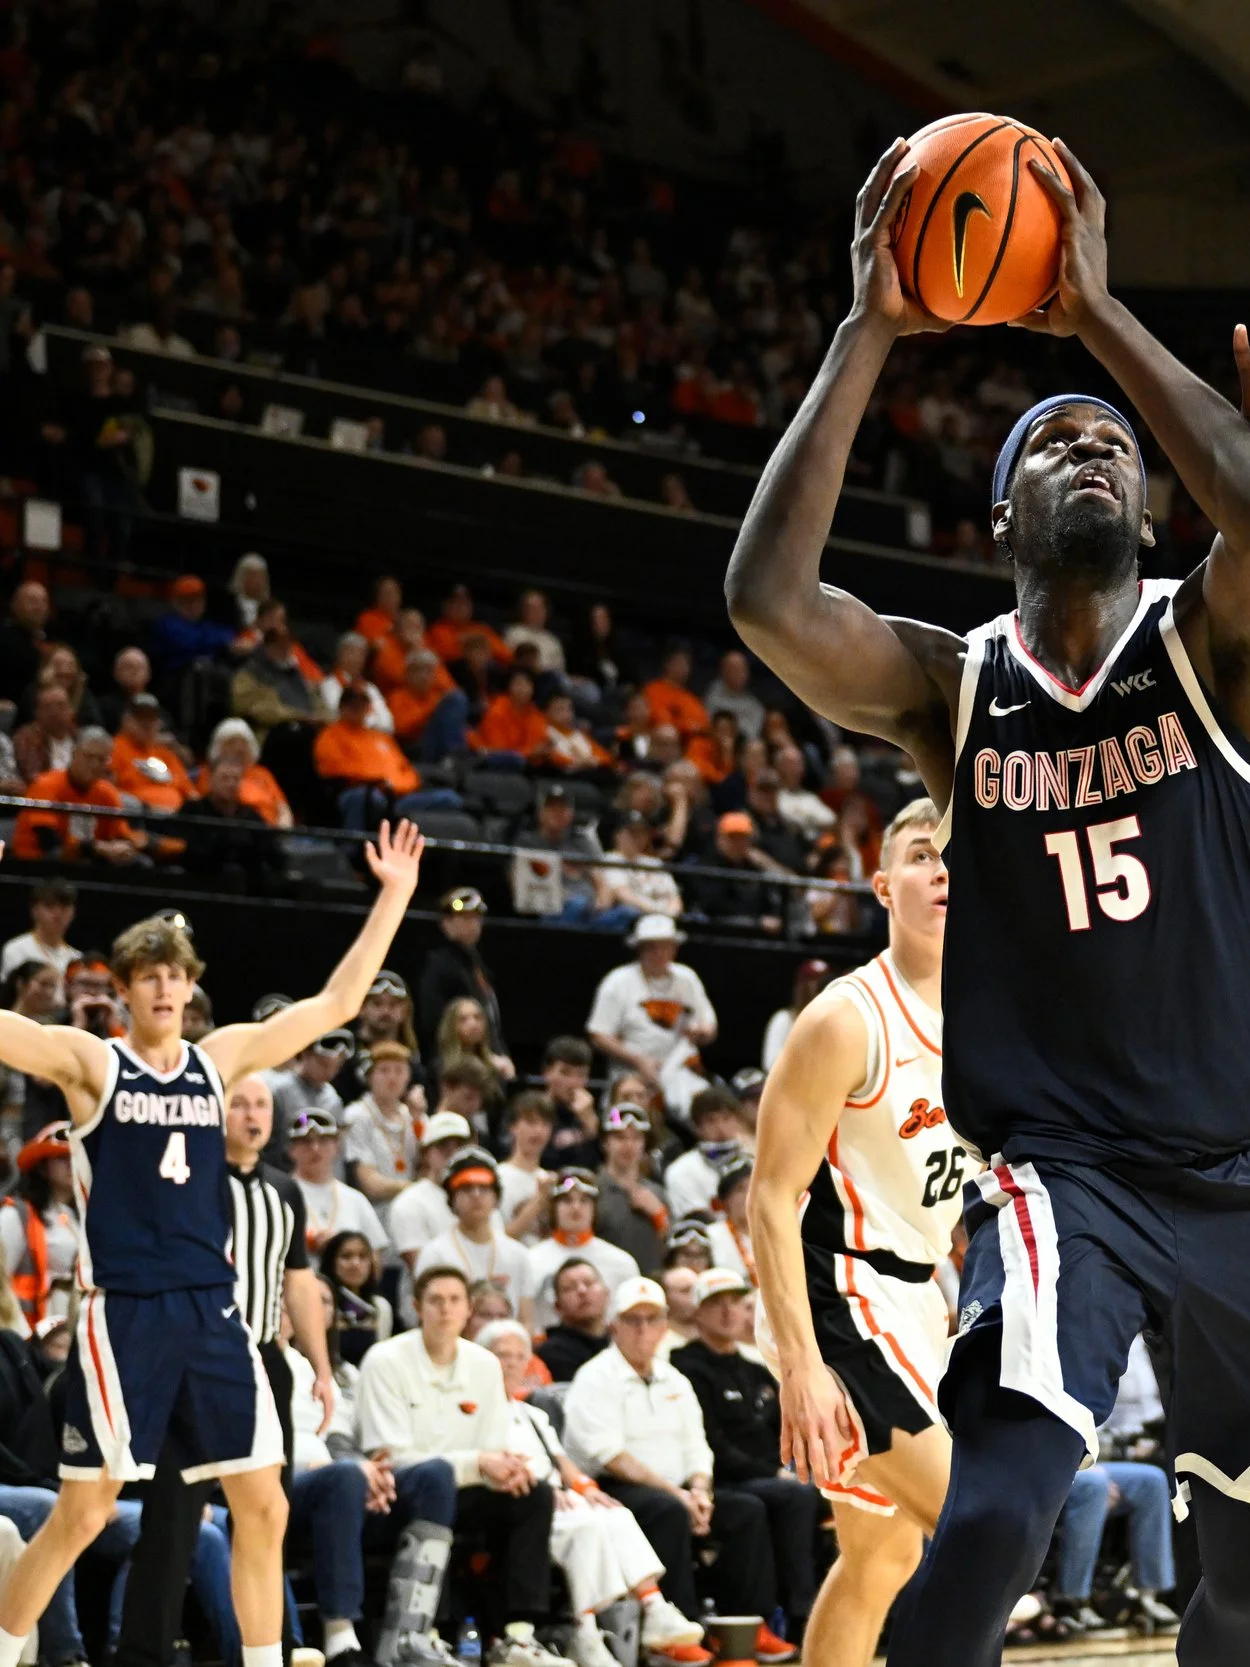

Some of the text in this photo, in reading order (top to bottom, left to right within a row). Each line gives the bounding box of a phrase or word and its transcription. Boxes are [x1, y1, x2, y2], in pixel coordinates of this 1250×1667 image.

[1109, 668, 1157, 698] WCC
[974, 711, 1198, 812] GONZAGA
[1044, 813, 1152, 932] 15
[115, 1090, 220, 1127] GONZAGA
[159, 1131, 191, 1185] 4
[921, 1146, 967, 1208] 26
